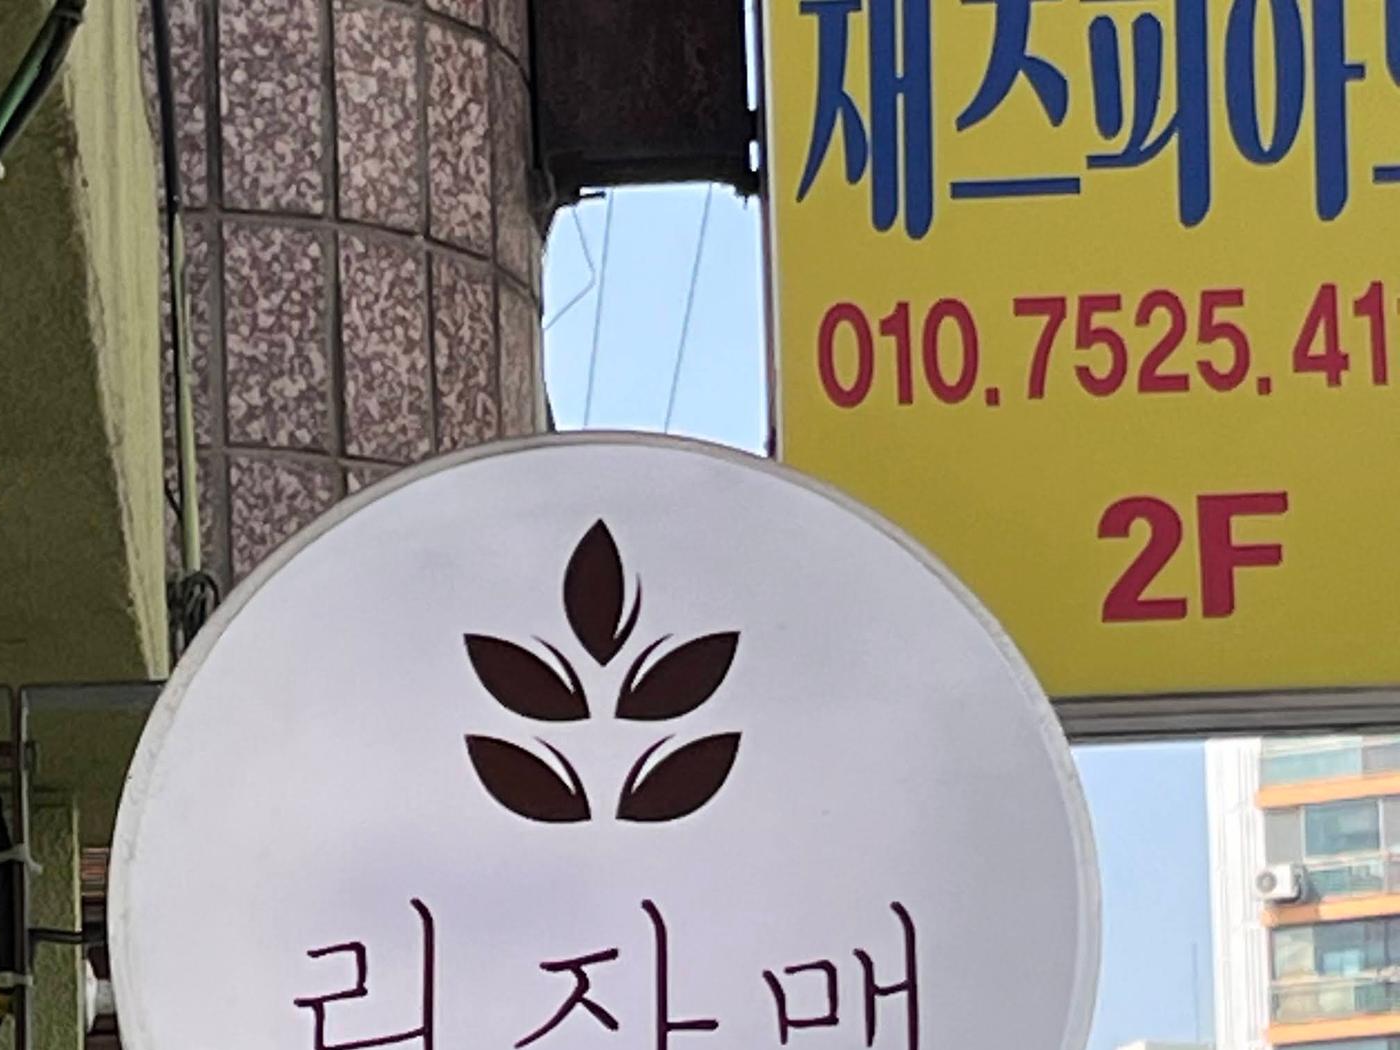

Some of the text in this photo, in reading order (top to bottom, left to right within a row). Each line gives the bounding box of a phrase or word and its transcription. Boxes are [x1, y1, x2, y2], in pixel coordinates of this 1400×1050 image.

[797, 0, 1400, 239] 재즈피아
[817, 280, 1400, 408] 010.7525.41
[1097, 491, 1289, 623] 2F
